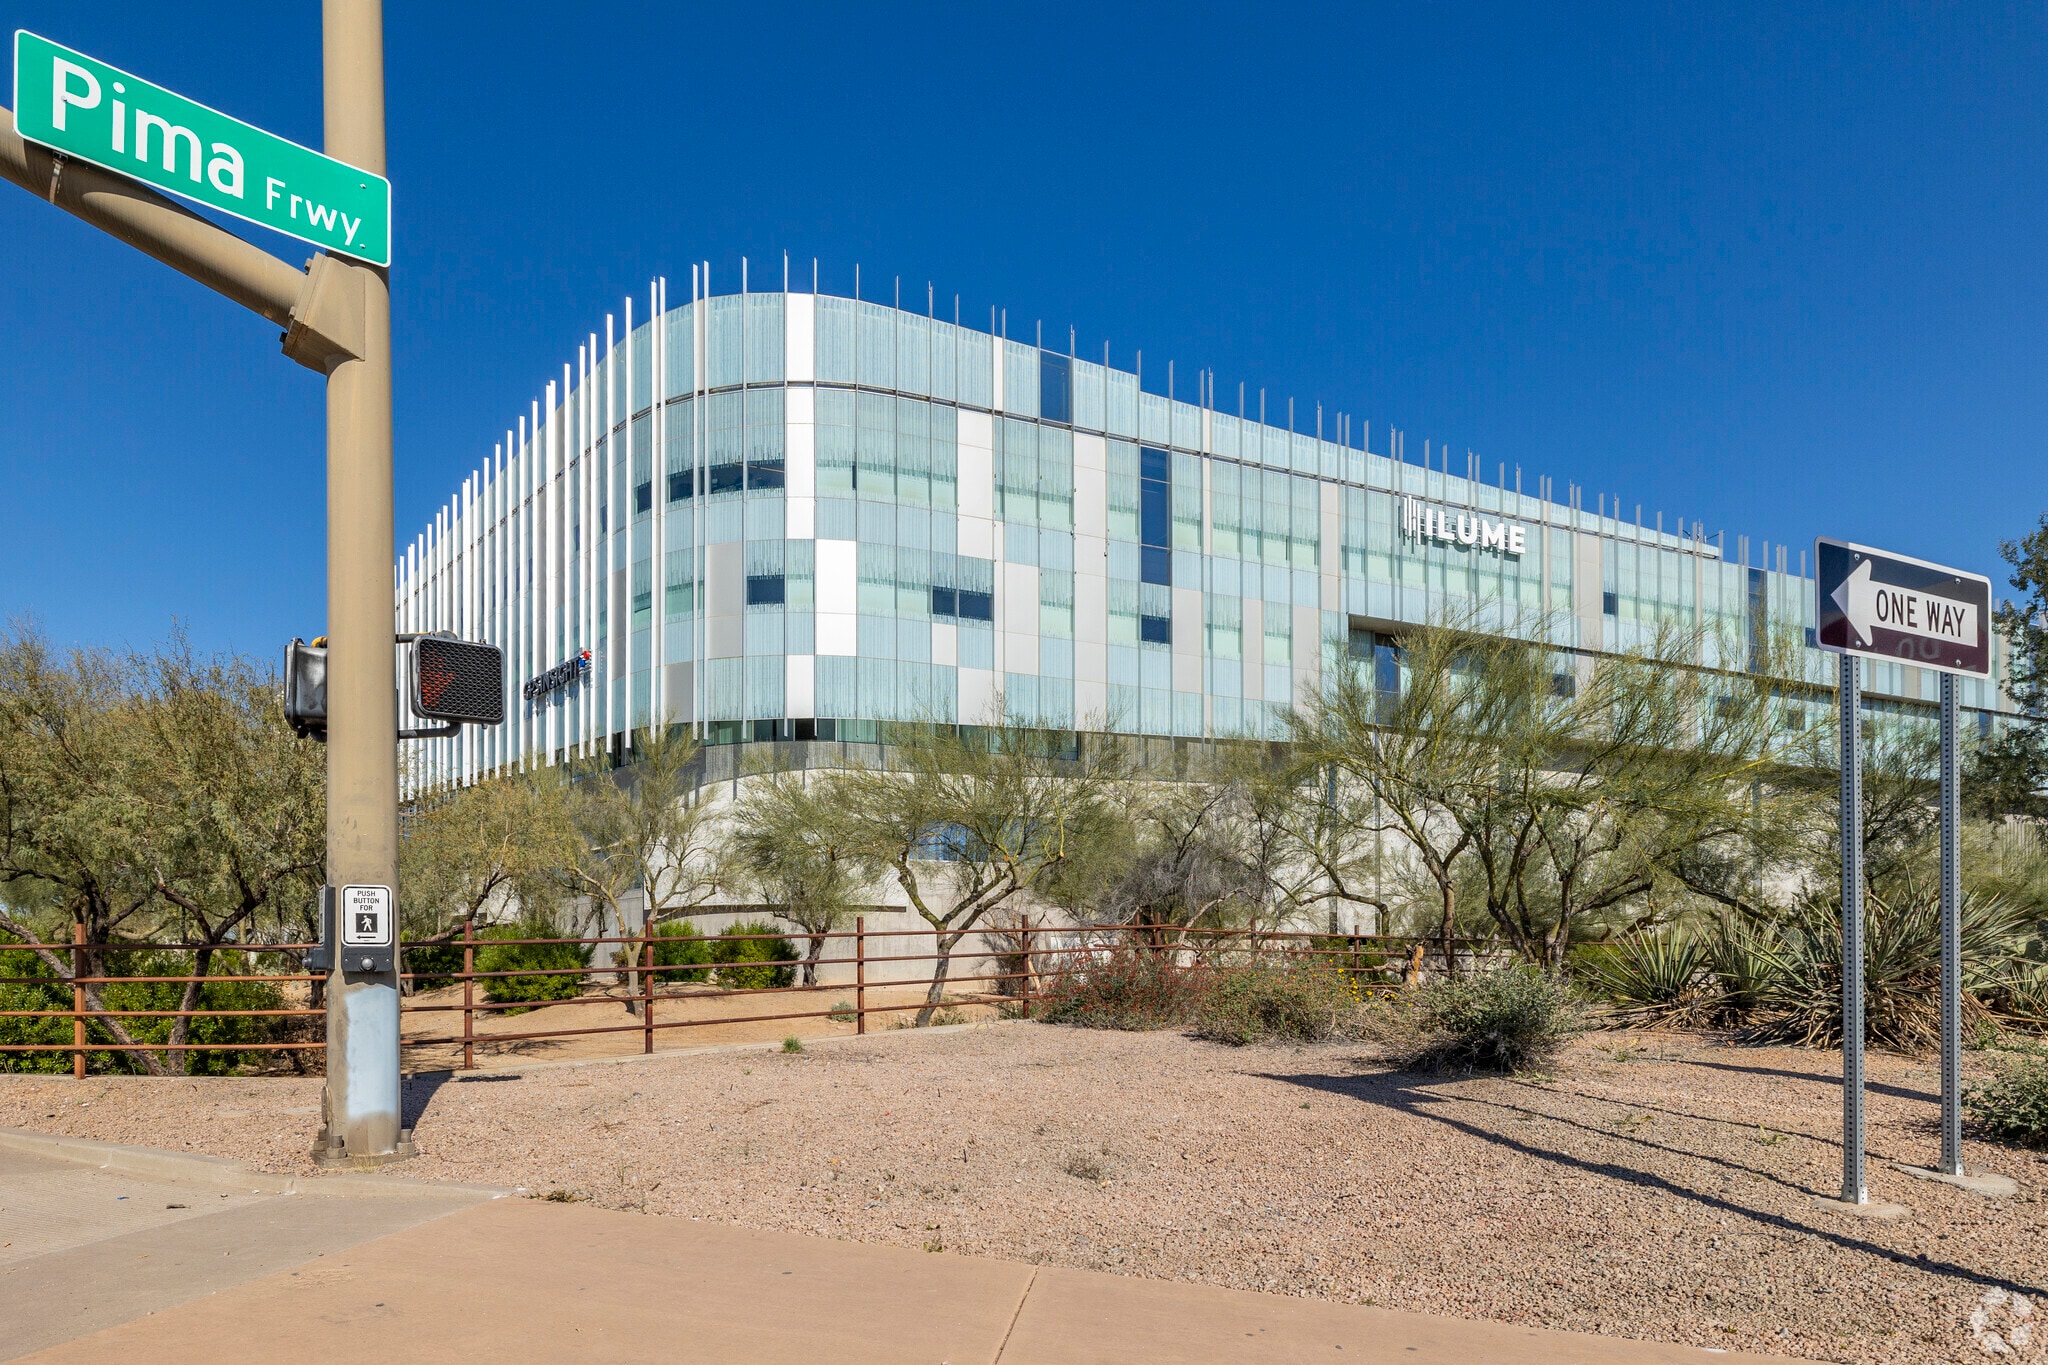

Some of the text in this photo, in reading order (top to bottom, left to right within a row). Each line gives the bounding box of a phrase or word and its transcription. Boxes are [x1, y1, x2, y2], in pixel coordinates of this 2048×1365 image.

[52, 56, 362, 246] Pima Frwy
[1876, 589, 1966, 637] ONE WAY
